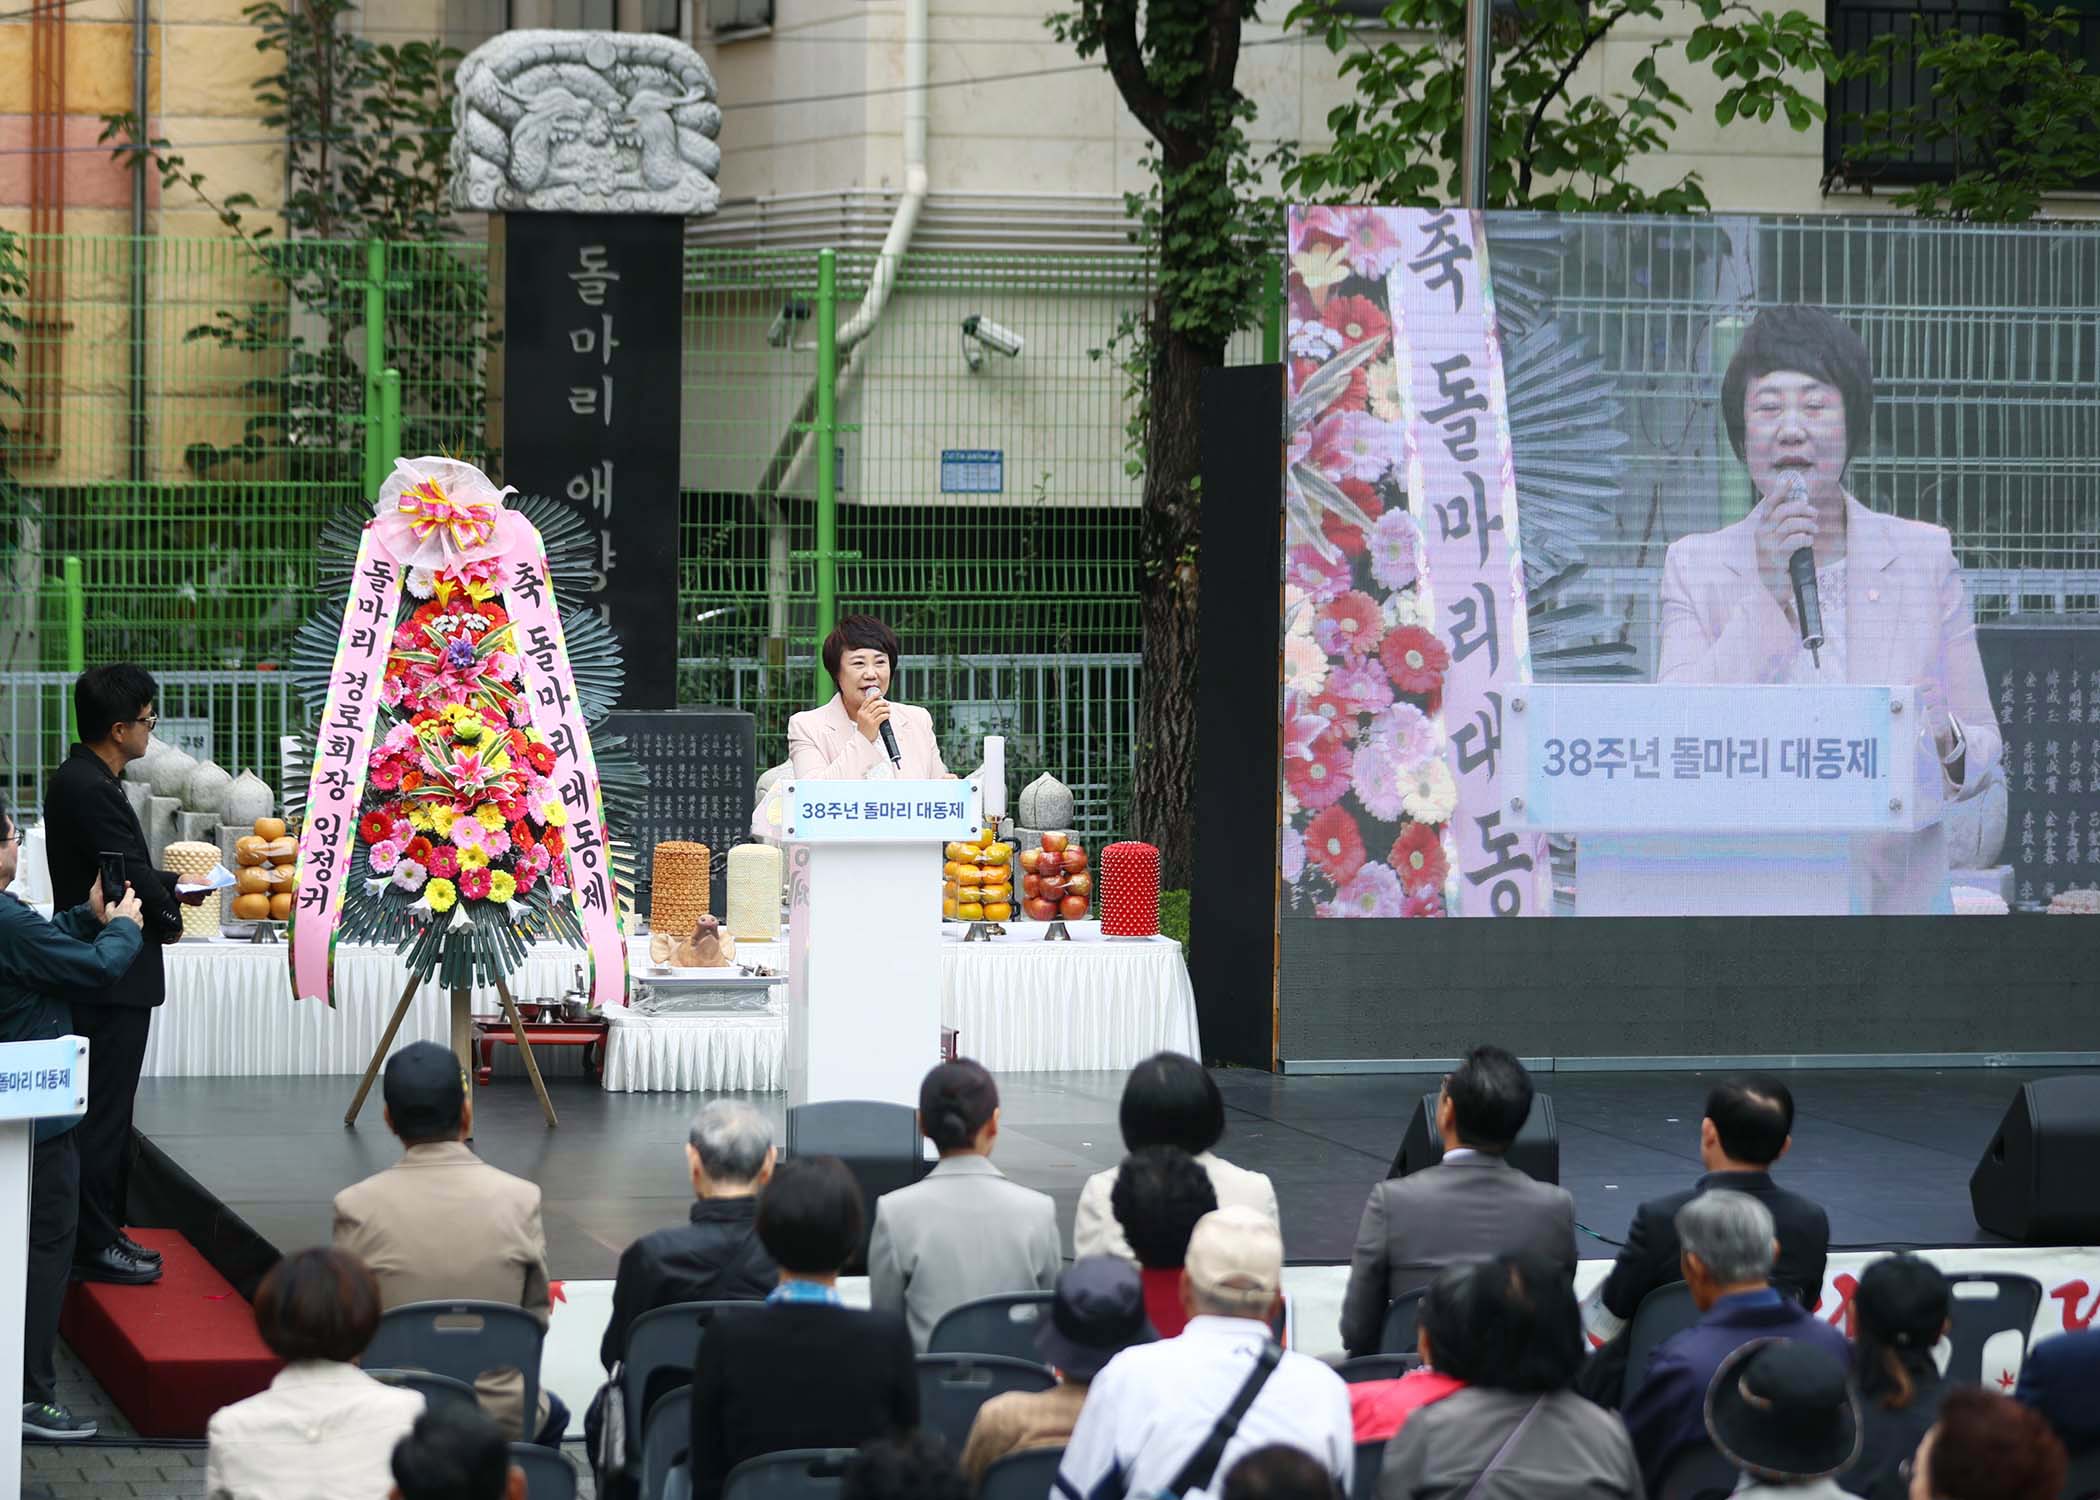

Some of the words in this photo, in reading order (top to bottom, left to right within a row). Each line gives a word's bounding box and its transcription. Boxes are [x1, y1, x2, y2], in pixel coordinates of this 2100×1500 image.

[567, 245, 620, 427] 돌마리
[350, 559, 395, 659] 돌마리
[511, 562, 545, 609] 축
[319, 670, 370, 802] 경로회장
[1543, 737, 1661, 780] 38주년
[1670, 737, 1769, 780] 돌마리
[1780, 737, 1878, 780] 대동제
[801, 802, 859, 820] 38주년
[863, 802, 911, 820] 돌마리
[916, 801, 965, 820] 대동제
[299, 813, 342, 916] 임정귀
[36, 1067, 71, 1090] 대동제
